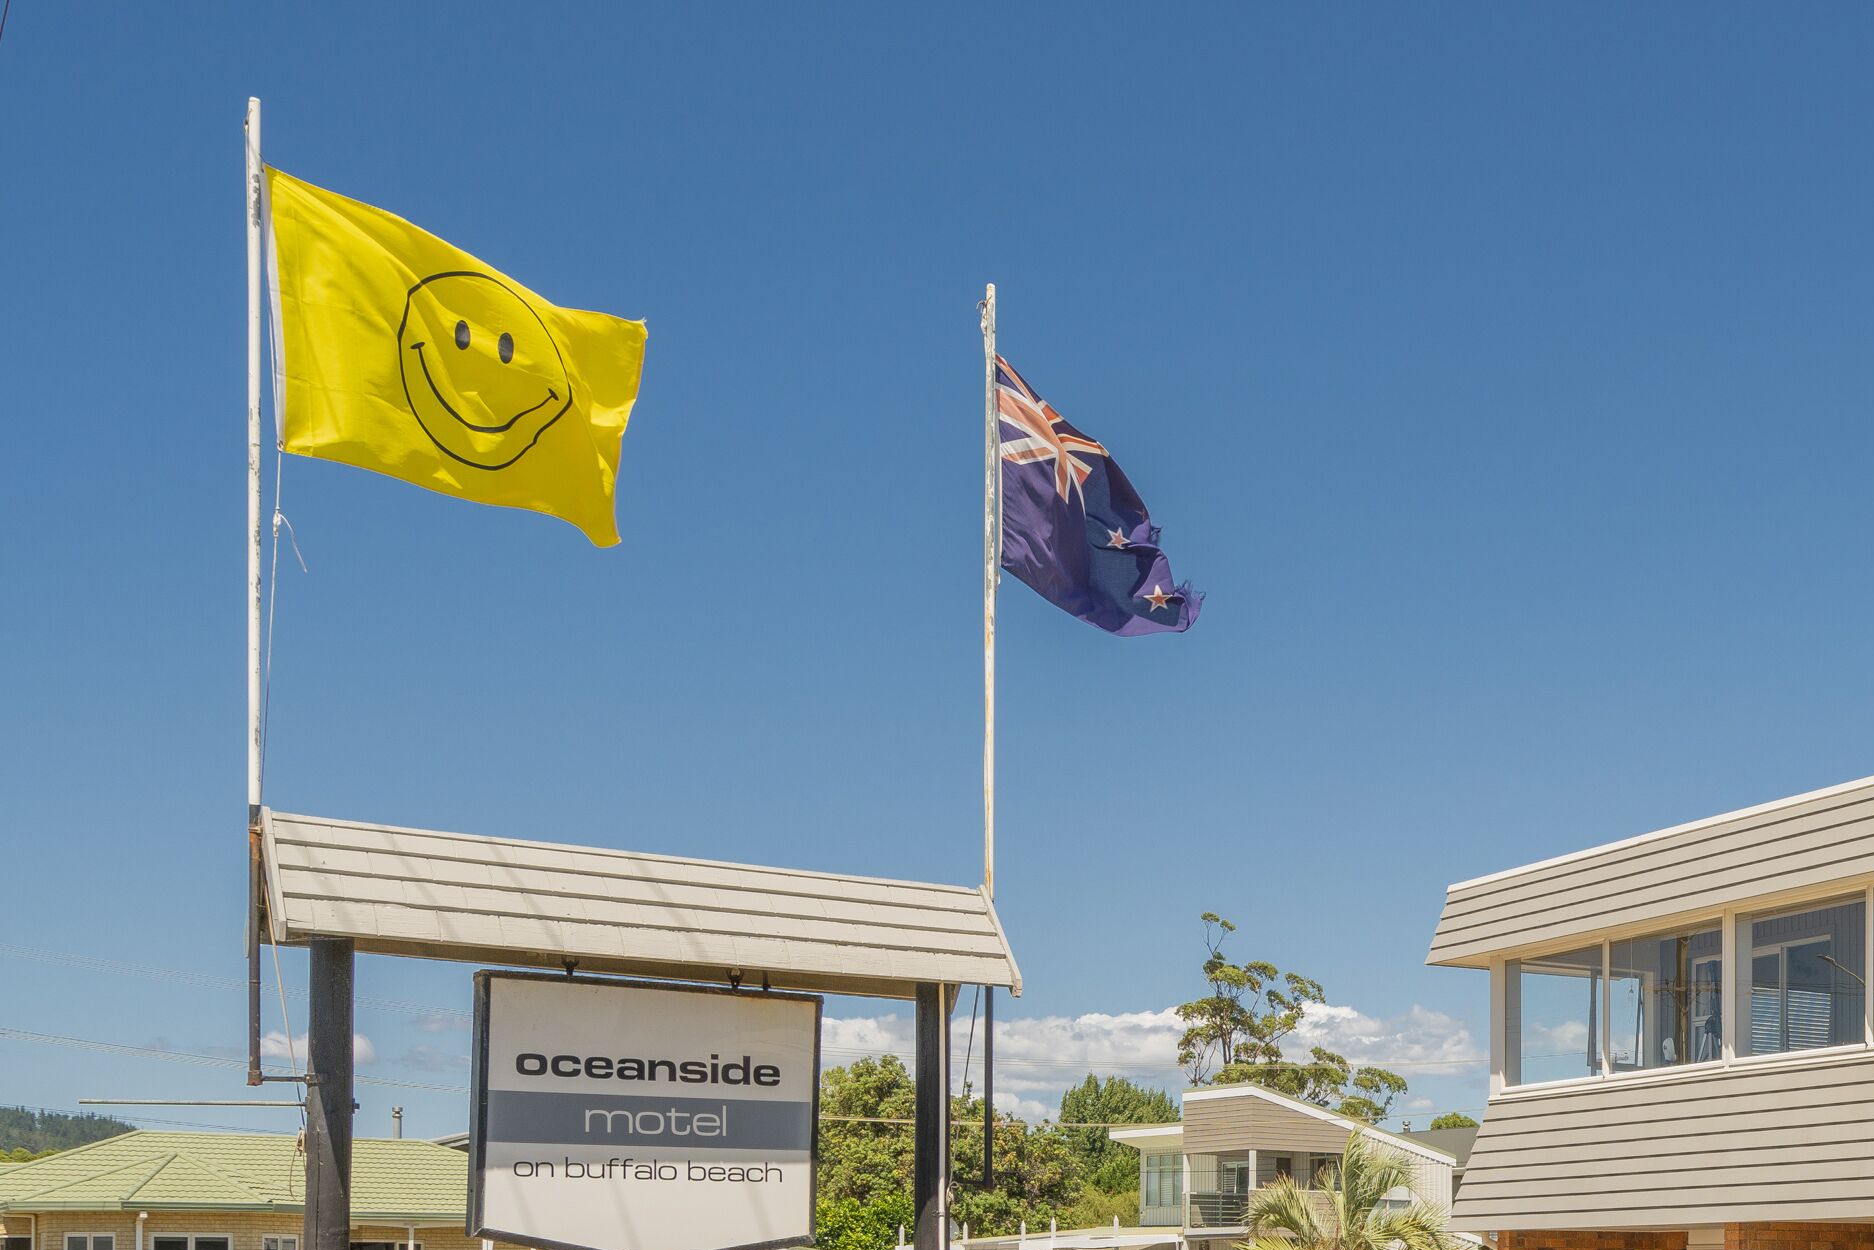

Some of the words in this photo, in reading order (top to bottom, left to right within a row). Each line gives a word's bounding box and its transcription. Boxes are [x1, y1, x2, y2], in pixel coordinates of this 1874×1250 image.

[515, 1053, 781, 1087] oceanside
[584, 1105, 728, 1138] motel
[513, 1160, 555, 1178] on
[565, 1156, 678, 1182] buffalo
[687, 1160, 783, 1183] beach
